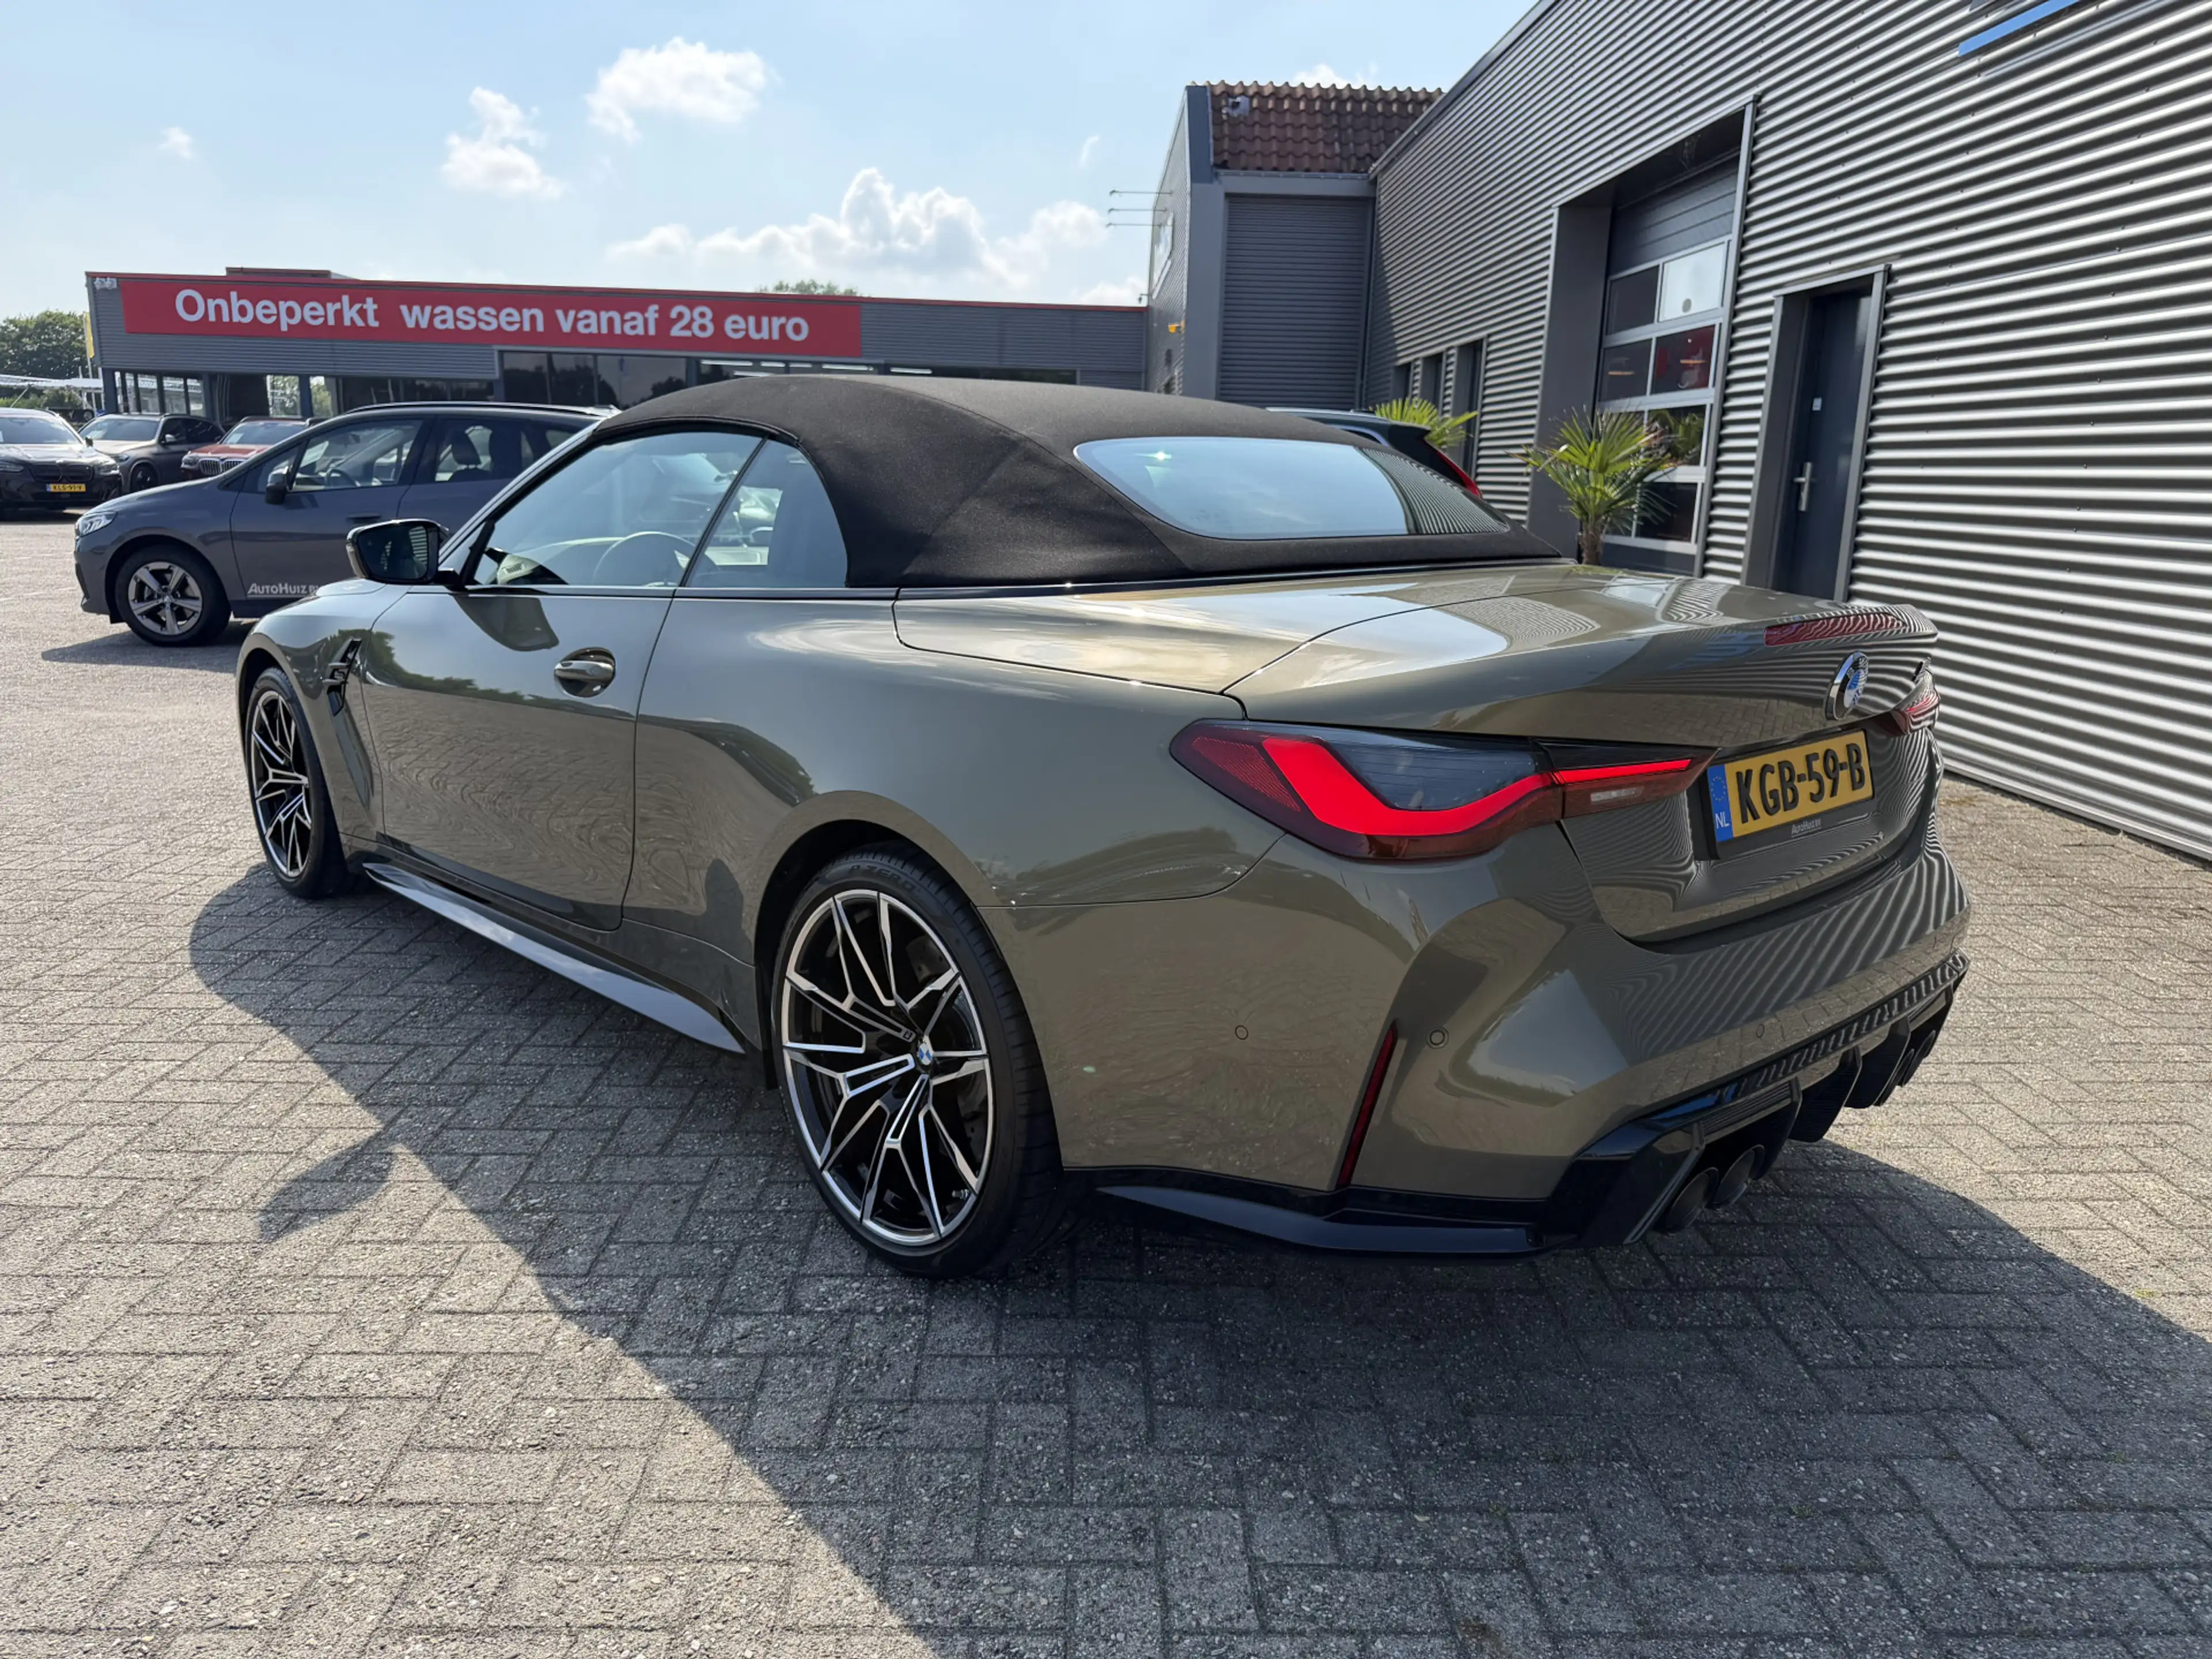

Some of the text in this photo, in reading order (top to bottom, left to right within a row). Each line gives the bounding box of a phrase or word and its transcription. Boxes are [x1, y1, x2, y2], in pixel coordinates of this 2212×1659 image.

[175, 289, 809, 341] Onbeperkt wassen vanaf 28 euro
[1736, 743, 1865, 824] KGB-59-B
[1715, 812, 1730, 829] NL
